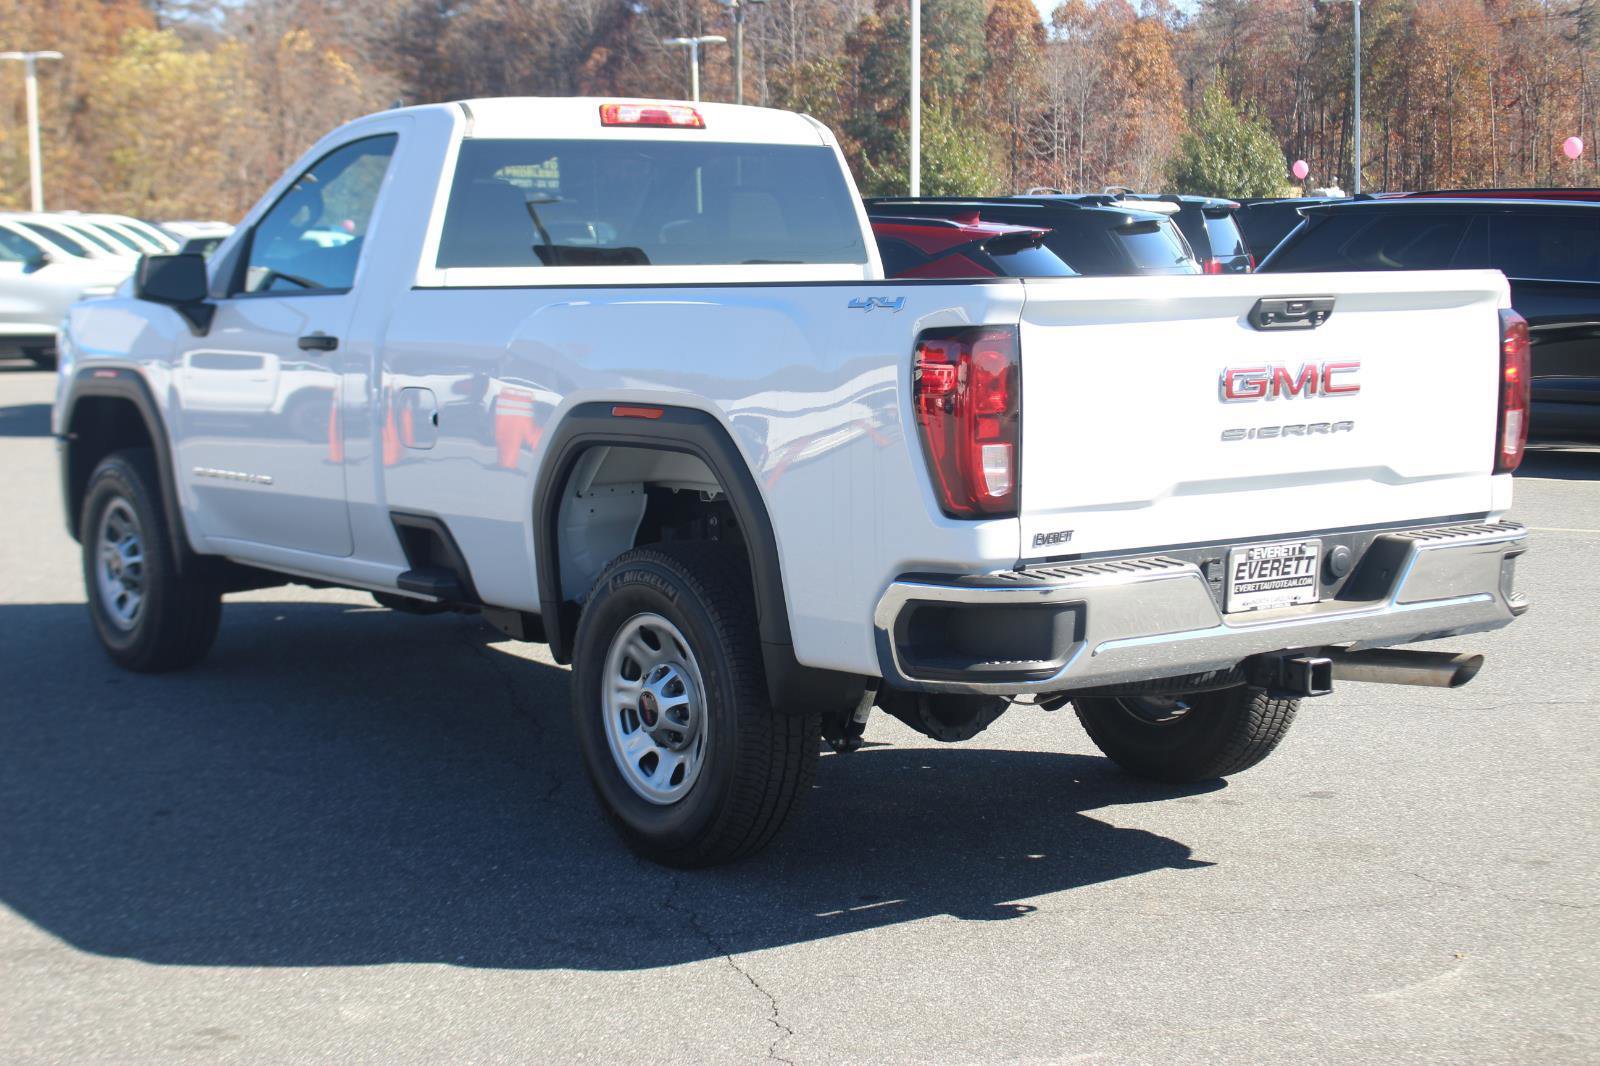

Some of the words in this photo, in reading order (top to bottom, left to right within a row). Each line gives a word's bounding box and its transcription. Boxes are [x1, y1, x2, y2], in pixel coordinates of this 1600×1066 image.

[1218, 361, 1361, 404] GMC
[1221, 420, 1355, 441] SIERRA
[1033, 530, 1075, 547] EVERETT
[1254, 544, 1300, 559] EVERETT
[1234, 555, 1316, 581] EVERETT
[623, 571, 676, 597] MICHELIN
[1235, 576, 1313, 593] EVERETTAUTOTEAM.COM
